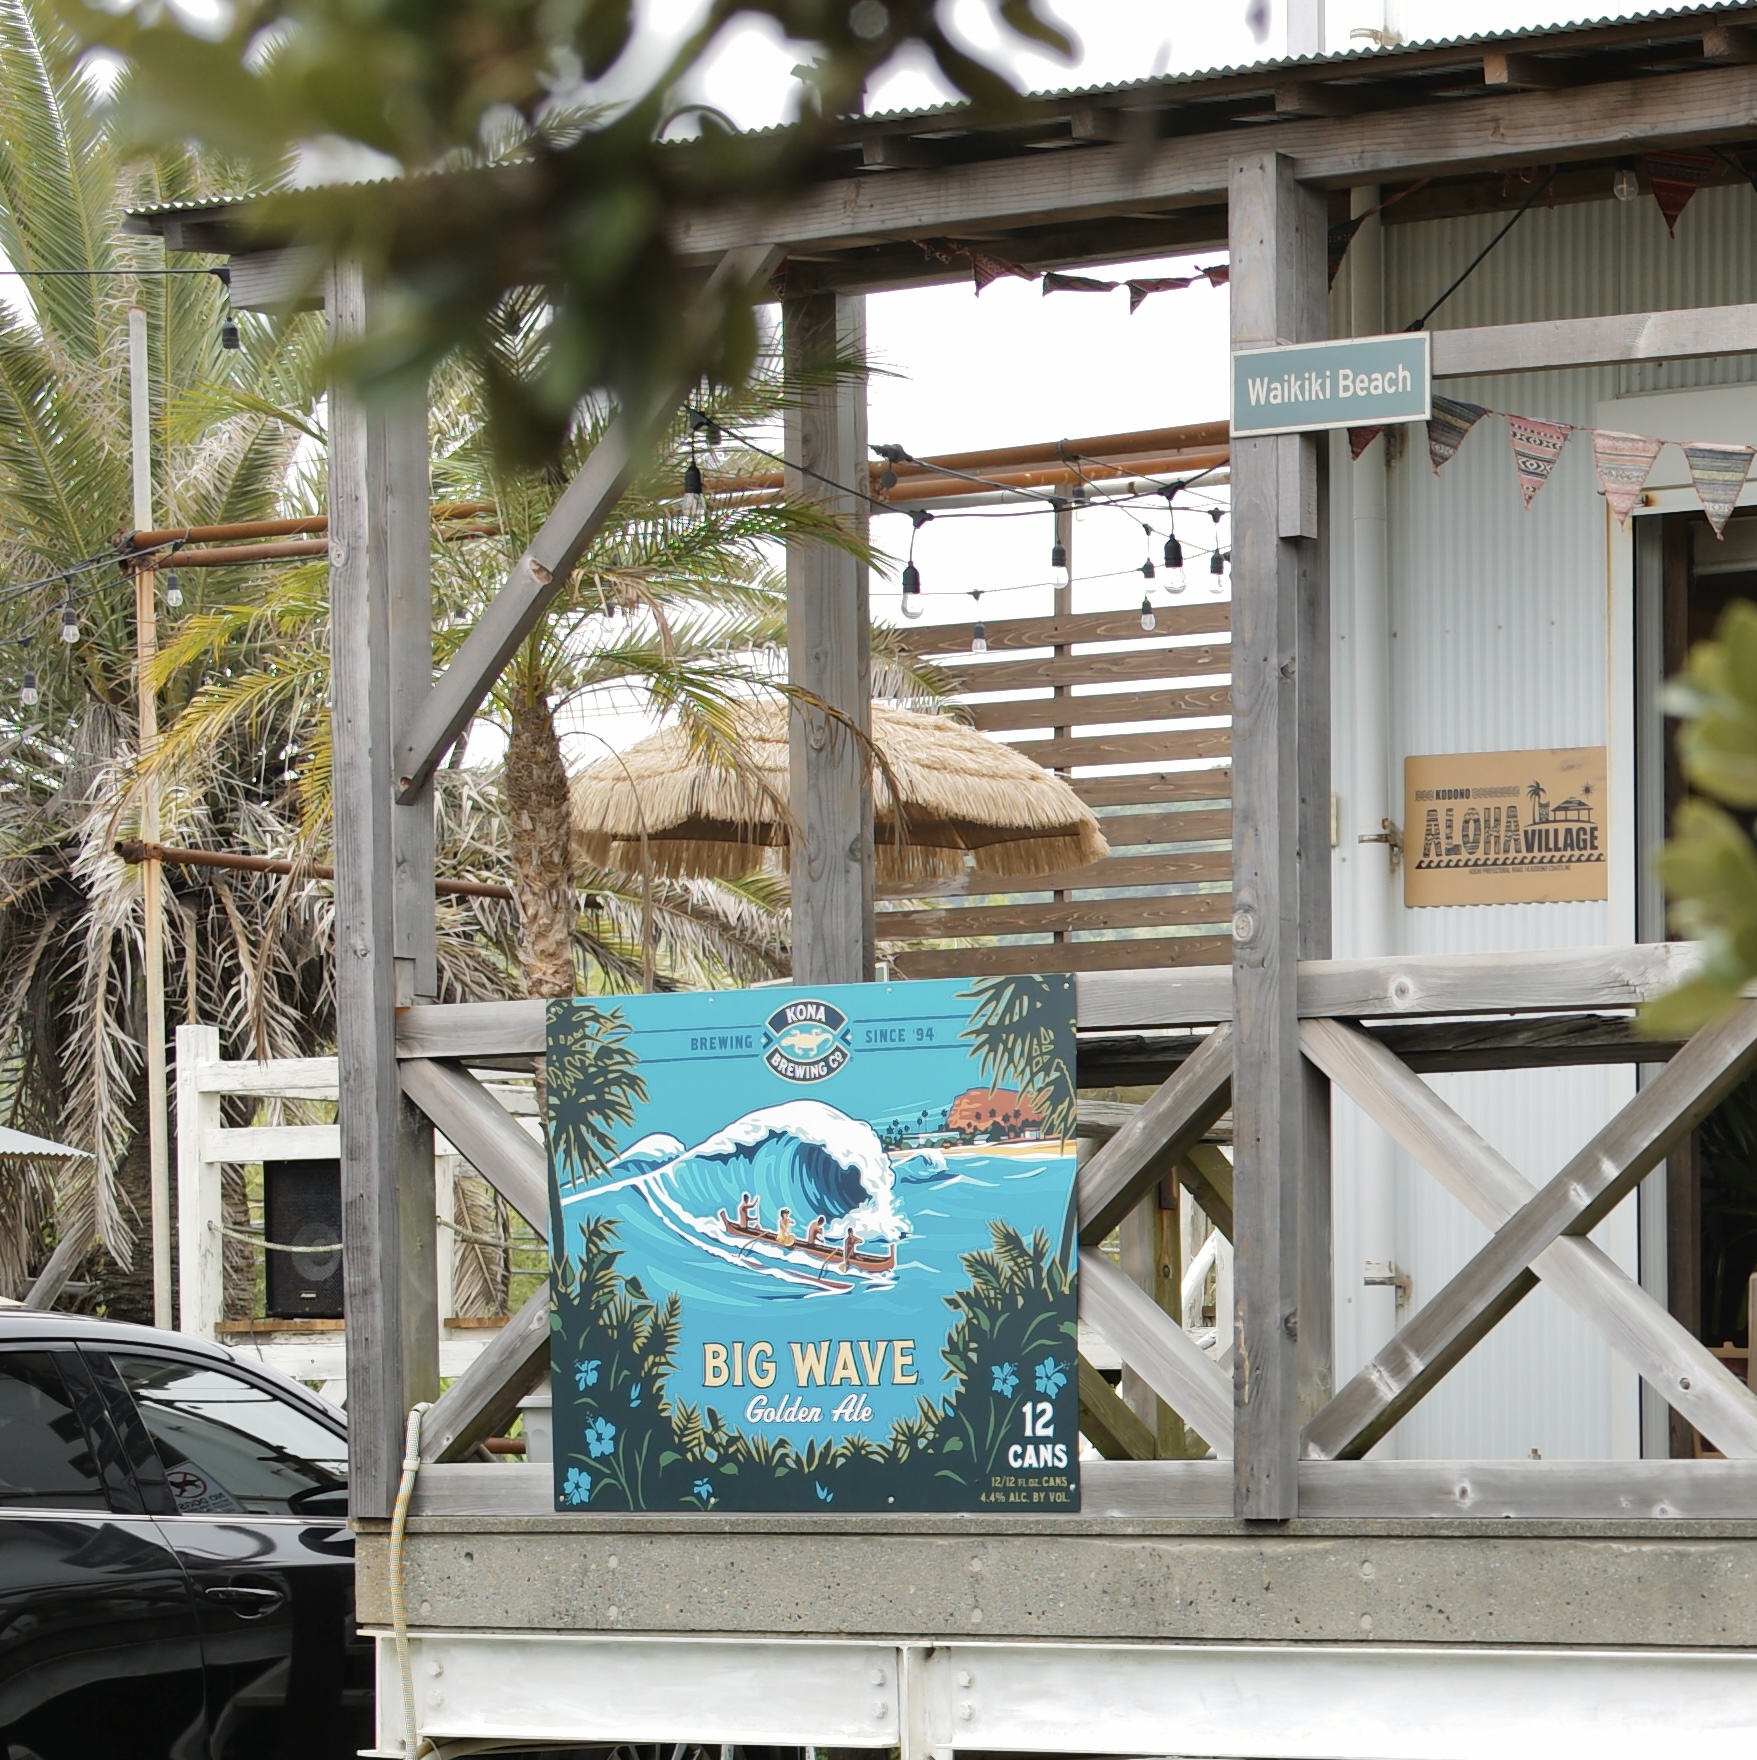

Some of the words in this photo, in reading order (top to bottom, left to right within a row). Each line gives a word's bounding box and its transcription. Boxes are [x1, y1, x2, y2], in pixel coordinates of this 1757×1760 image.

[1247, 370, 1331, 406] Waikiki
[1338, 364, 1412, 398] Beach
[1435, 788, 1471, 800] KODONO
[1423, 805, 1522, 858] ALOHA
[1523, 826, 1599, 853] VILLAGE
[785, 1004, 826, 1023] KONA
[690, 1036, 753, 1051] BREWING
[865, 1029, 906, 1044] SINCE
[770, 1052, 829, 1080] BREWING
[702, 1340, 778, 1389] BIG
[787, 1337, 920, 1389] WAVE
[745, 1394, 824, 1424] Golden
[831, 1393, 875, 1423] Ale
[1020, 1401, 1055, 1438] 12
[1007, 1443, 1069, 1470] CANS
[990, 1476, 1016, 1489] 12/12
[1042, 1476, 1069, 1488] CANS
[1032, 1492, 1047, 1503] BY
